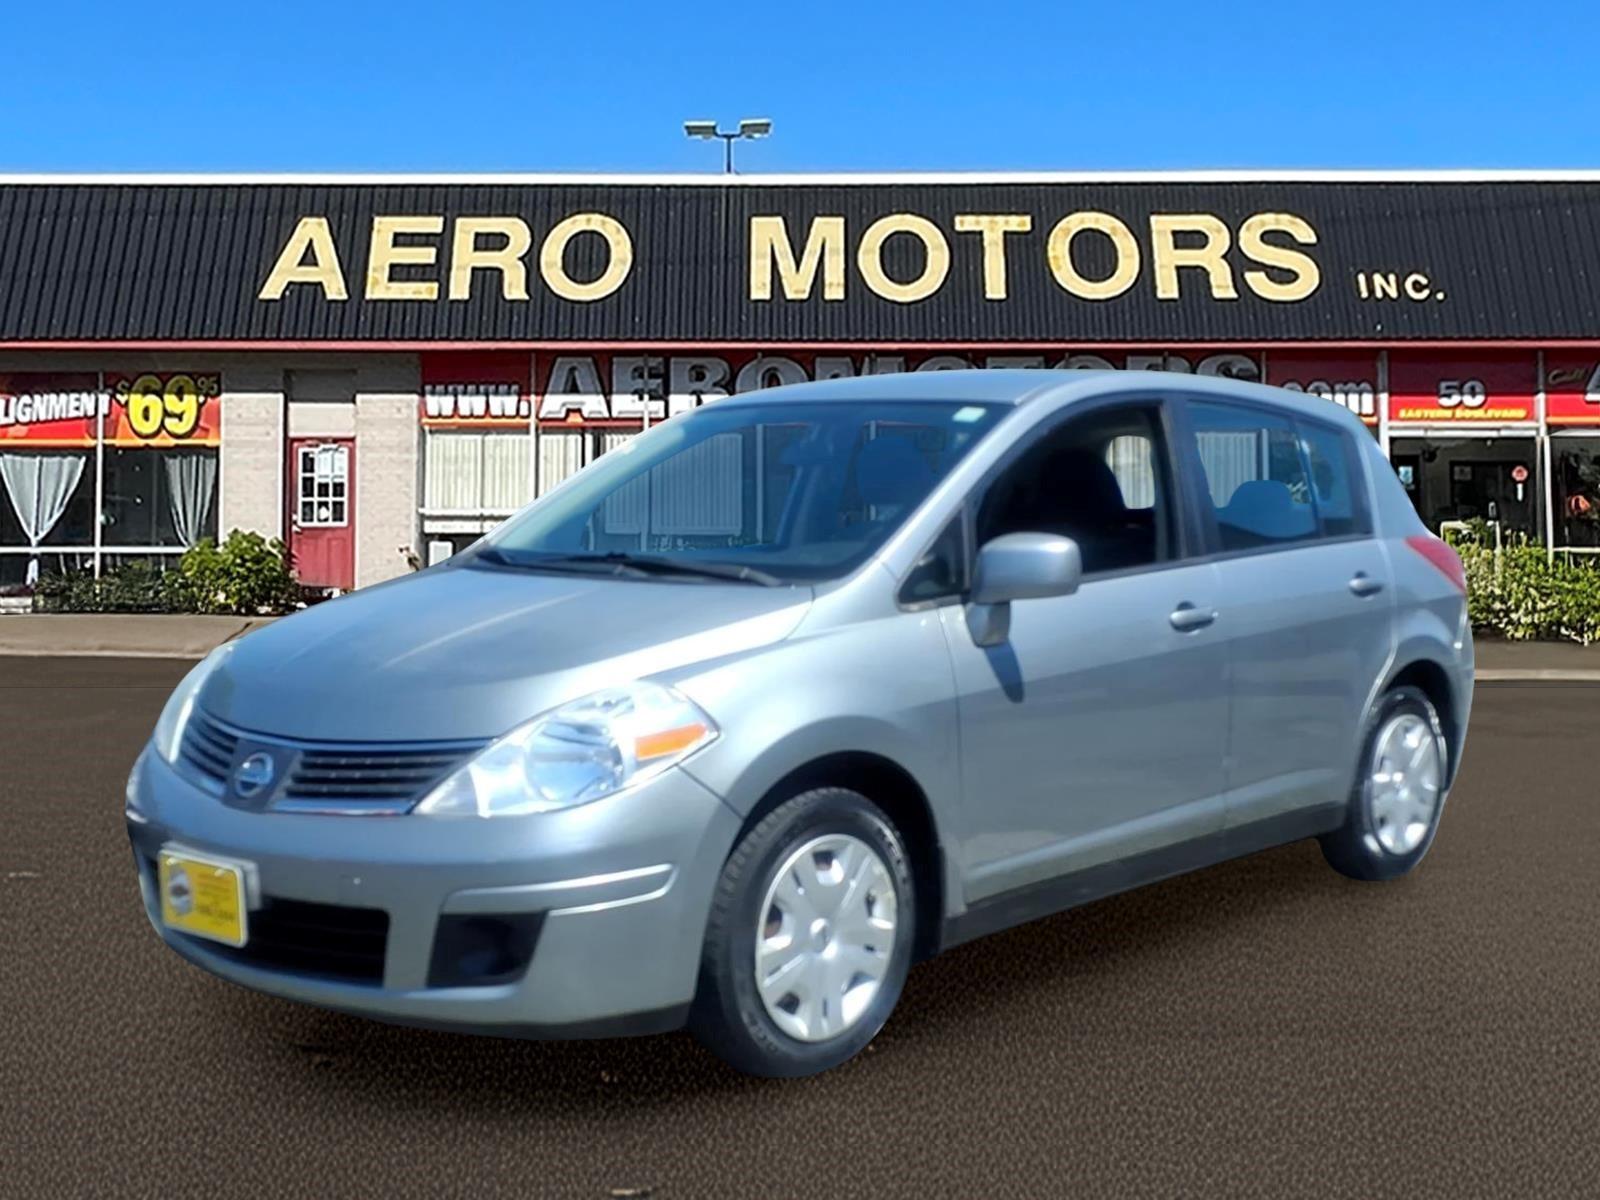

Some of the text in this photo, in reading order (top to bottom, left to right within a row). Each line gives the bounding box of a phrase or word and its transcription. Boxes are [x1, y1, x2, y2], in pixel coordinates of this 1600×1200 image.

[258, 211, 1447, 304] AERO MOTORS INC.
[1437, 380, 1486, 407] 50
